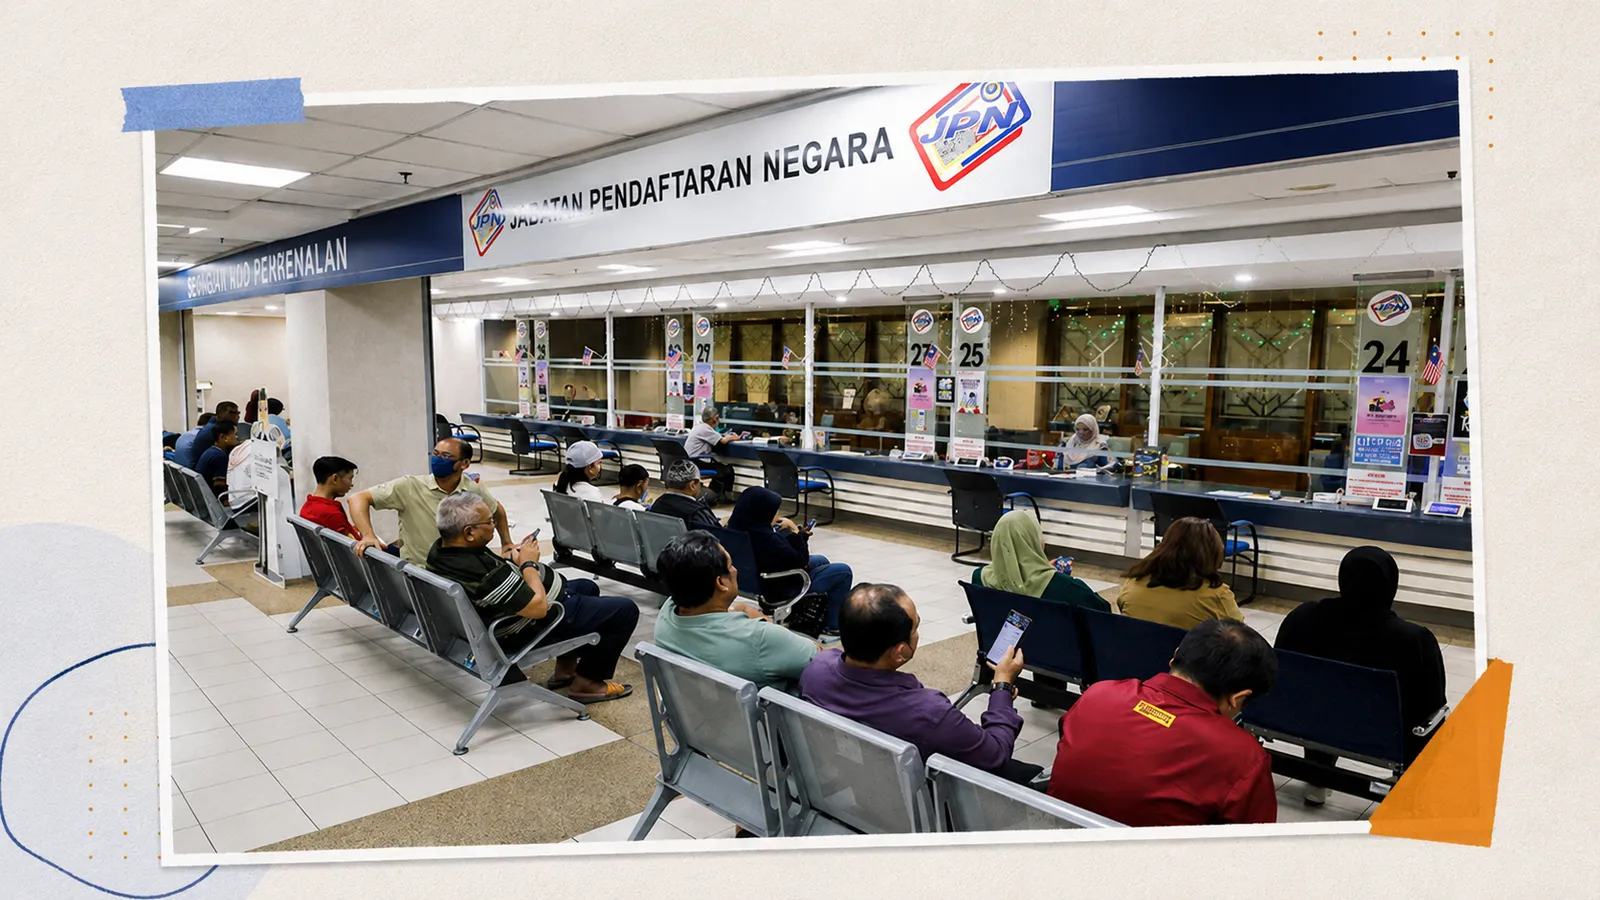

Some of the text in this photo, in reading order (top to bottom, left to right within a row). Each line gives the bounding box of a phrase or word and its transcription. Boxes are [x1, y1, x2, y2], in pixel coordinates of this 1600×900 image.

[919, 101, 1020, 145] JPN
[590, 154, 752, 214] PENDAFTARAN
[763, 126, 894, 183] NEGARA
[472, 212, 502, 231] JPN
[697, 343, 711, 363] 29
[959, 343, 984, 367] 25
[1362, 340, 1410, 373] 24
